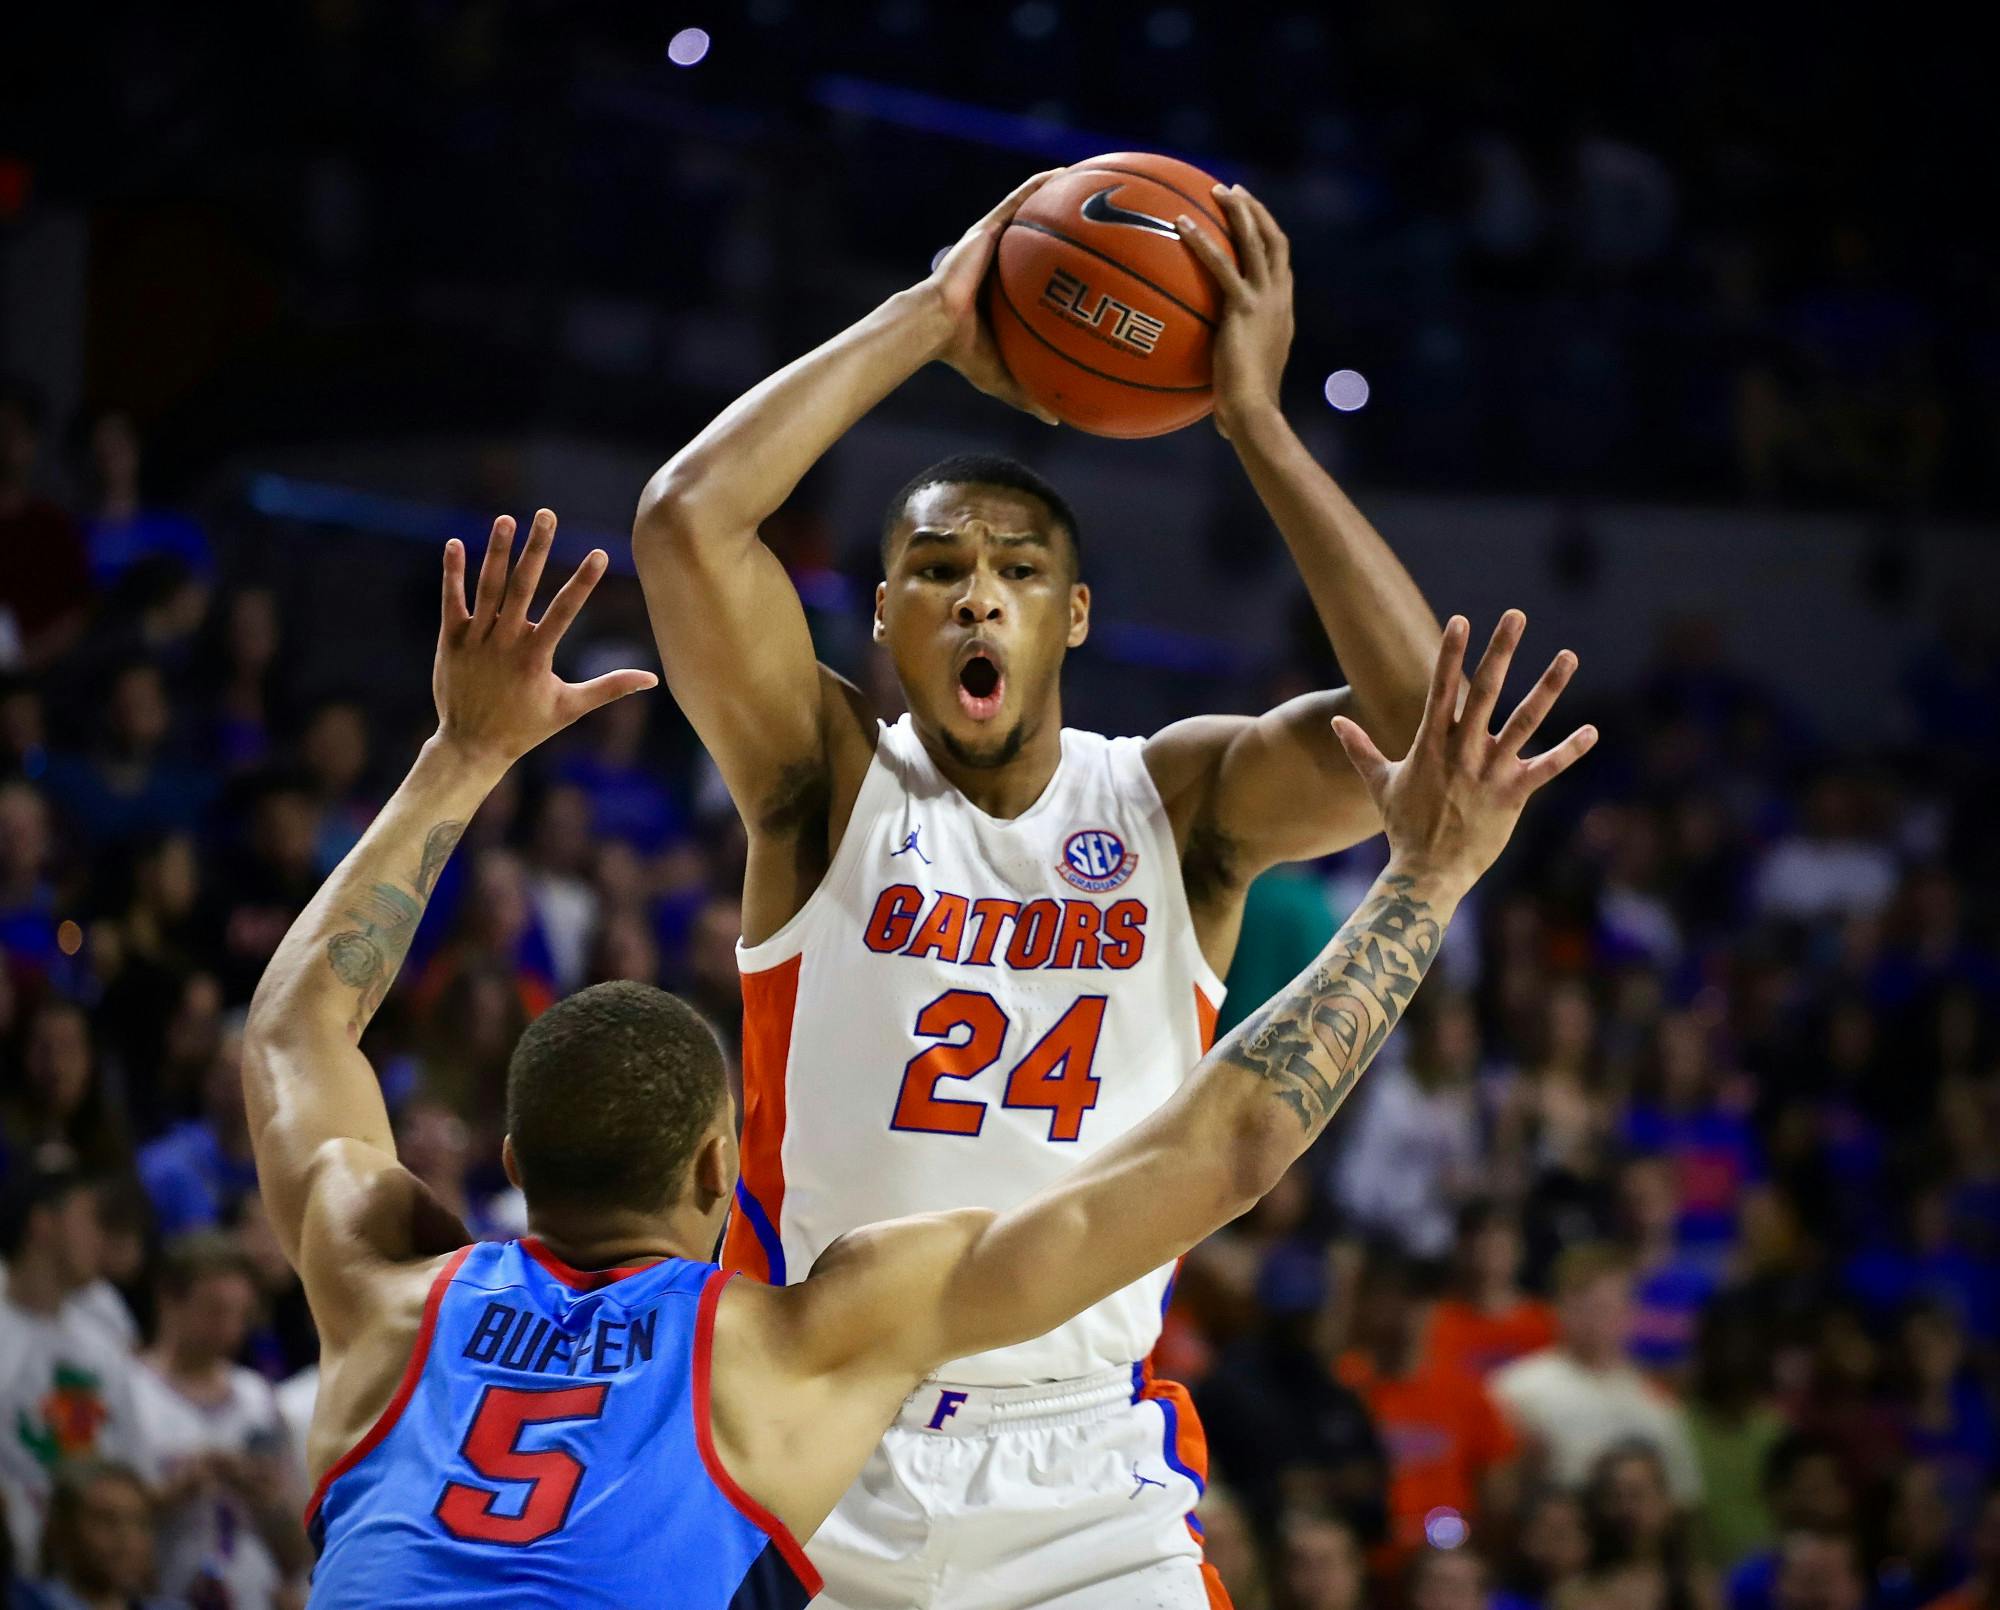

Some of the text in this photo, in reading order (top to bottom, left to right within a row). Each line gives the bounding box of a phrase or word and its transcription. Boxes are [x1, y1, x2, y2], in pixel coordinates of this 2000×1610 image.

[1044, 266, 1165, 353] ELITE
[1068, 833, 1121, 876] SEC
[863, 883, 1147, 970] GATORS
[889, 988, 1108, 1142] 24
[924, 1389, 968, 1431] F
[431, 1381, 613, 1548] 5
